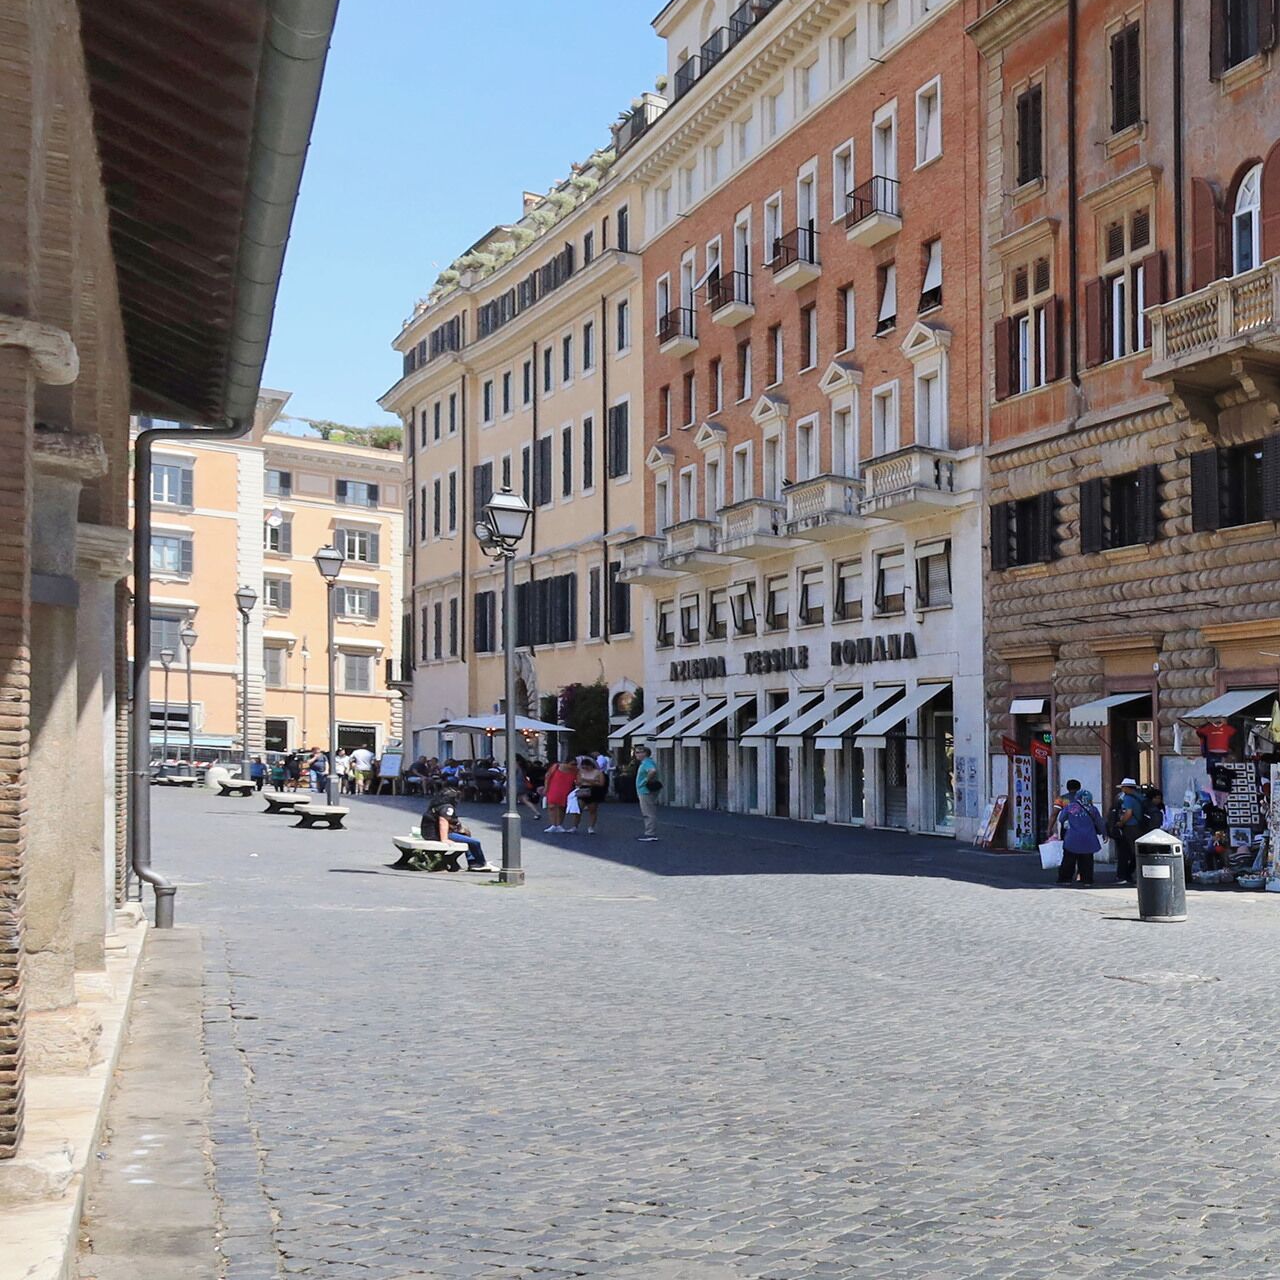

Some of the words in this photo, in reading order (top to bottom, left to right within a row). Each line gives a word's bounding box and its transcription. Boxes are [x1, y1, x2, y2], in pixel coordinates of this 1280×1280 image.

[670, 656, 727, 681] AZIENDA
[744, 645, 809, 675] TESSILE
[831, 632, 917, 666] ROMANA
[1022, 758, 1031, 791] MINI
